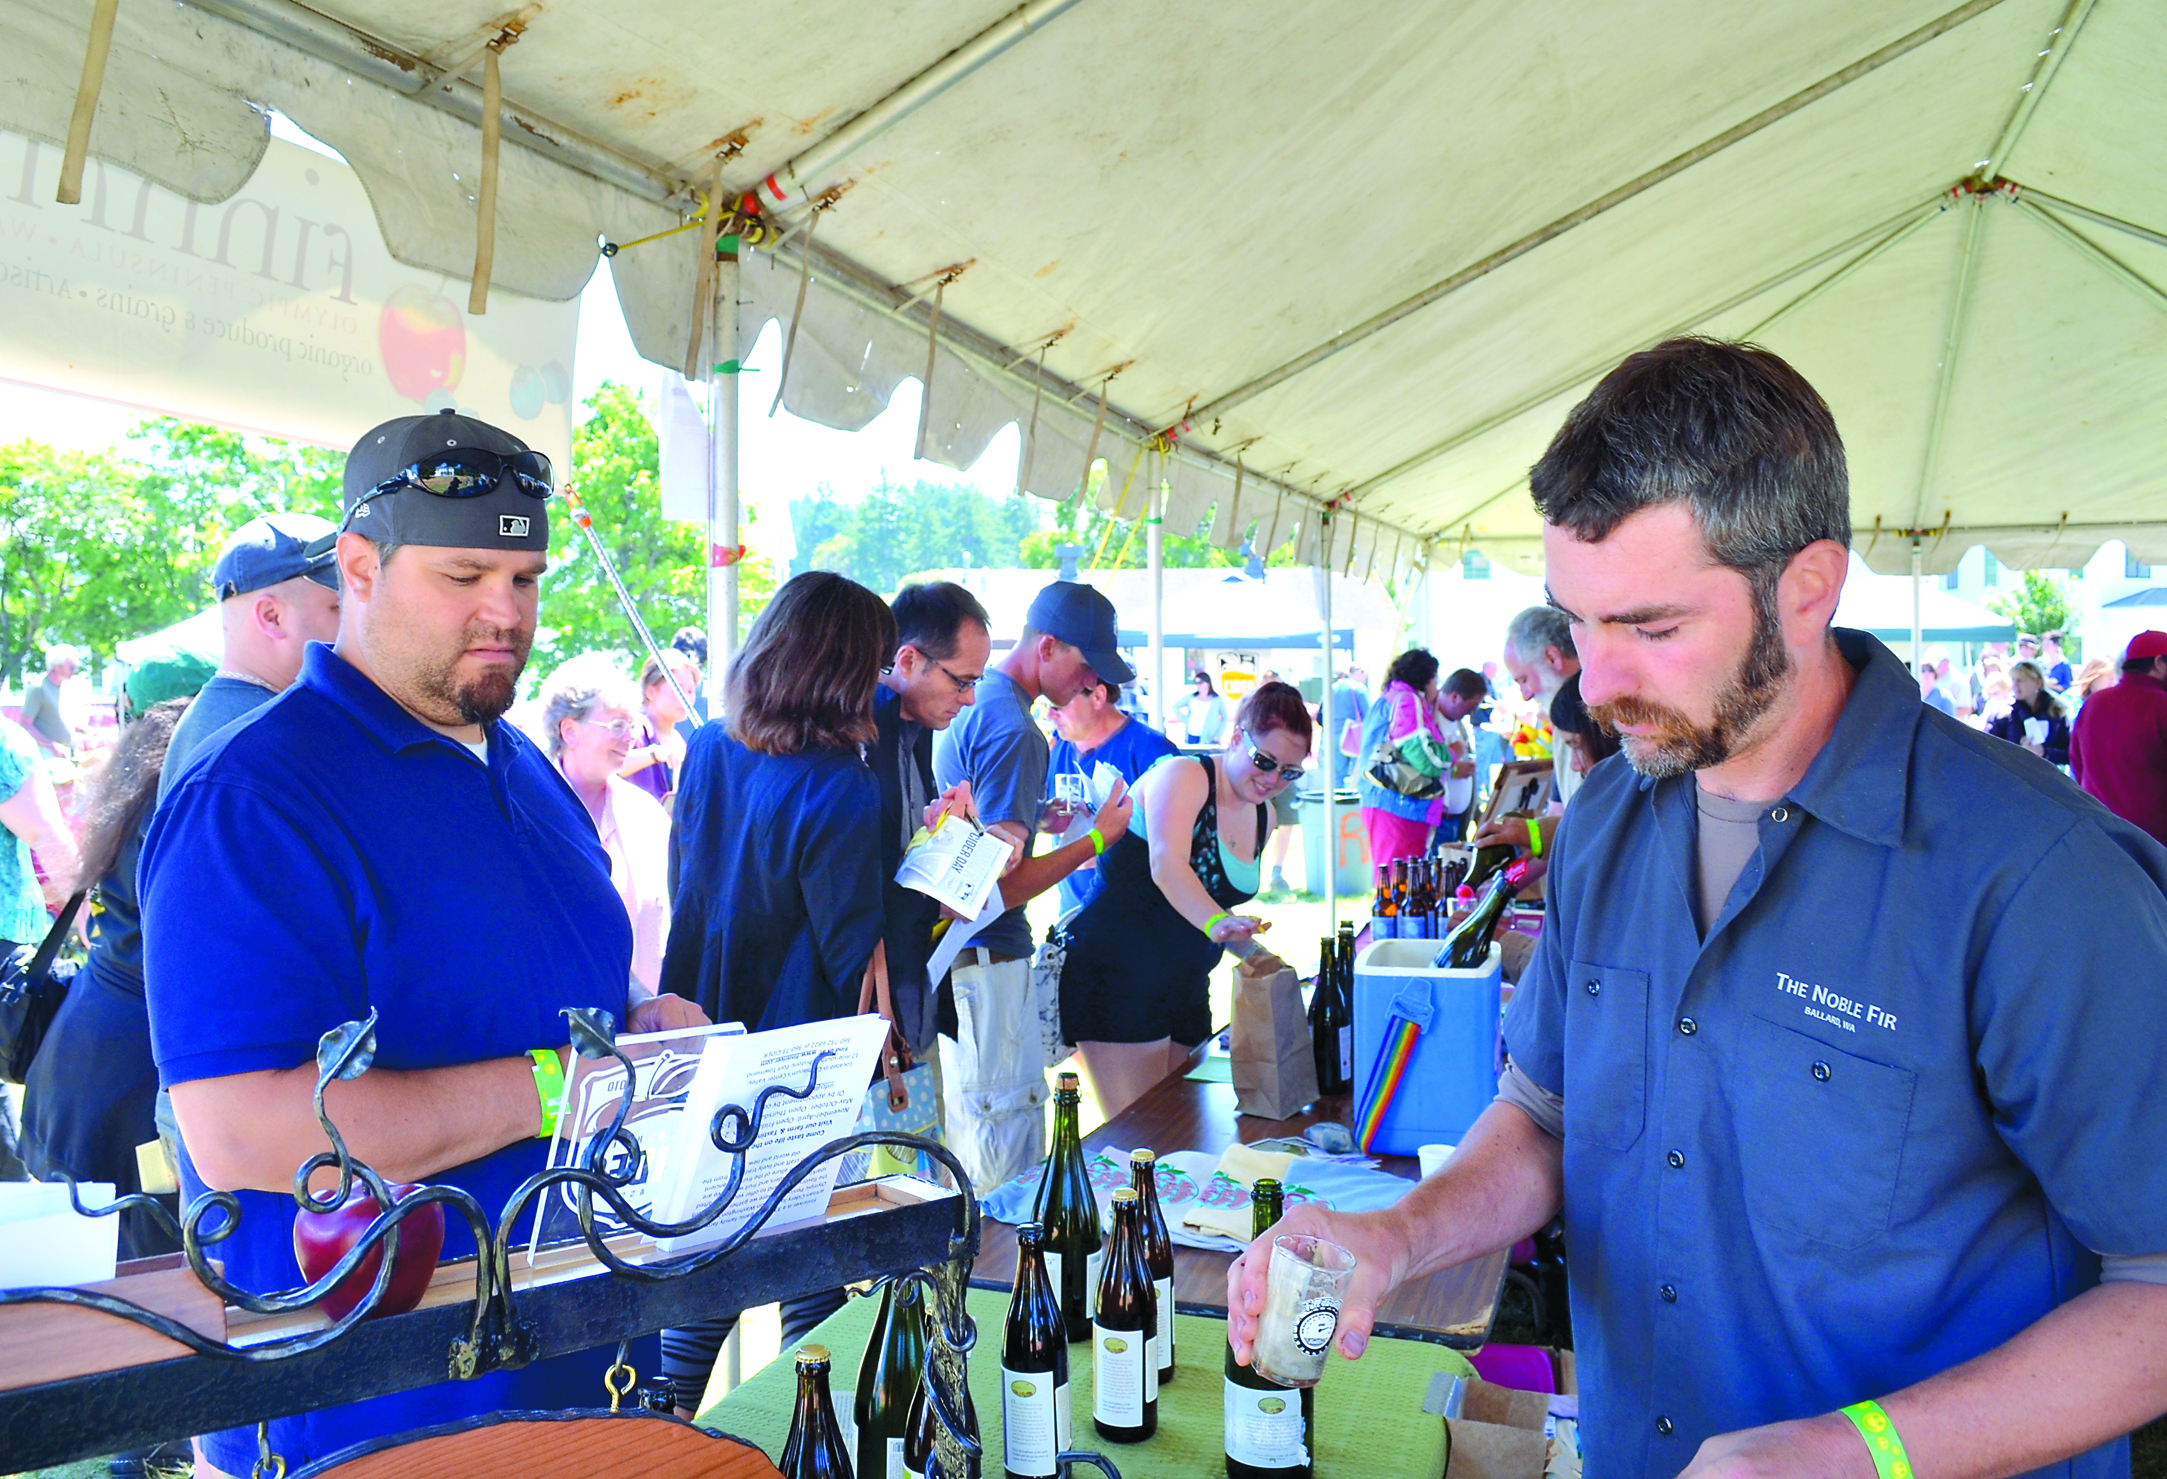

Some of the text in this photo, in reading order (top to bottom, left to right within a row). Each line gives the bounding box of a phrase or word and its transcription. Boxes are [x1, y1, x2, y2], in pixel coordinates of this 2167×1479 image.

[951, 832, 981, 874] CIDER DAY
[1777, 972, 1897, 1031] THE NOBLE FIR
[1804, 1006, 1855, 1033] BALLARD, WA
[786, 1104, 807, 1116] Open
[774, 1115, 795, 1127] Open
[804, 1121, 817, 1129] our
[816, 1118, 834, 1128] Visit
[778, 1127, 786, 1135] &
[785, 1124, 804, 1134] farm
[804, 1128, 825, 1139] Come
[773, 1136, 786, 1145] life
[785, 1132, 804, 1142] taste
[750, 1141, 763, 1150] the
